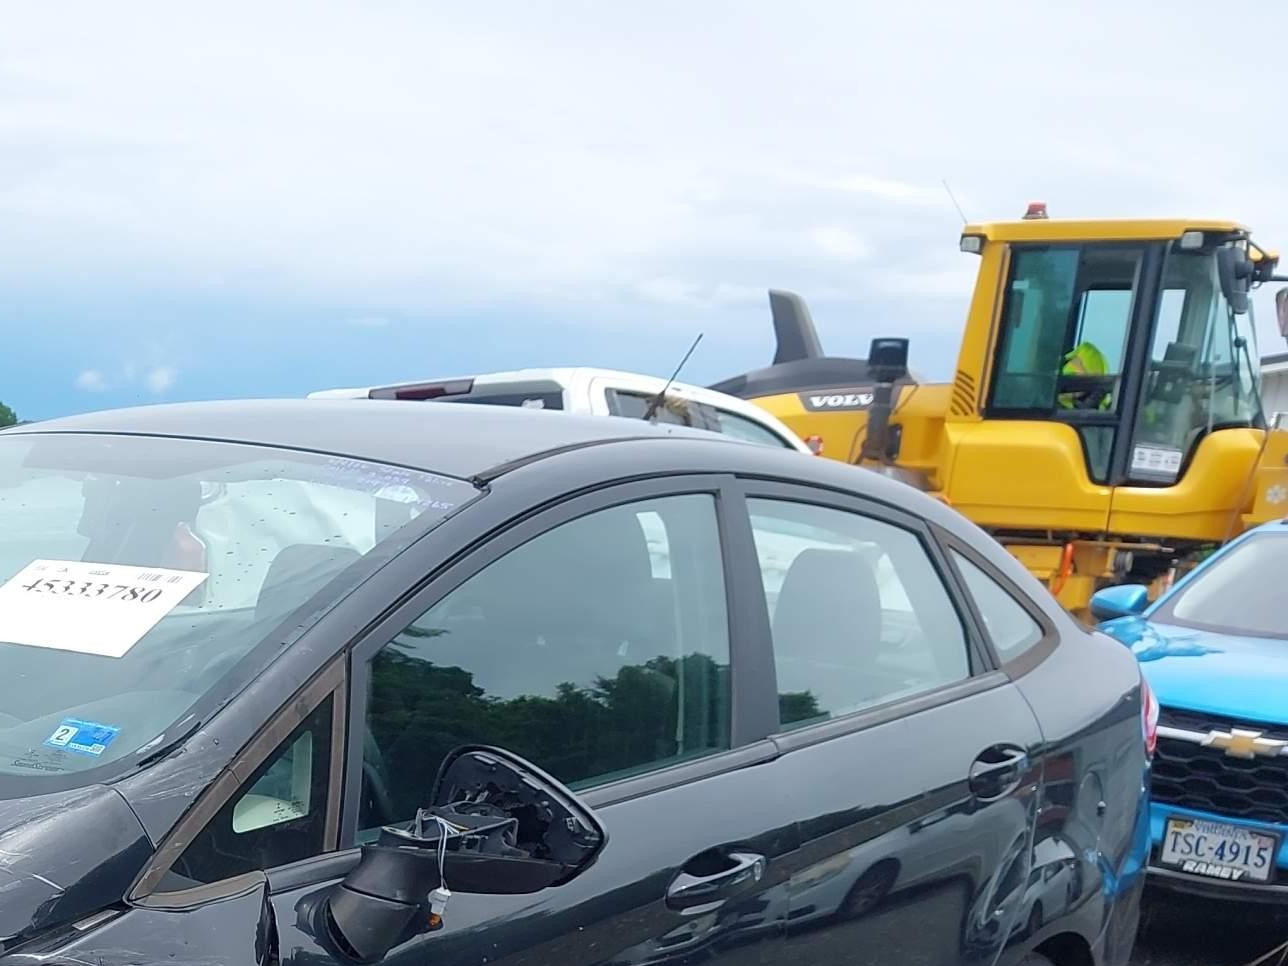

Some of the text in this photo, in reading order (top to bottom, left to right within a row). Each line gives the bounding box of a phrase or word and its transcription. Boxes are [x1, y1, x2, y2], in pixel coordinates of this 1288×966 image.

[810, 393, 873, 408] VOLV
[21, 578, 163, 604] 45333780
[55, 728, 70, 741] 2
[1171, 830, 1268, 868] TSC-4915
